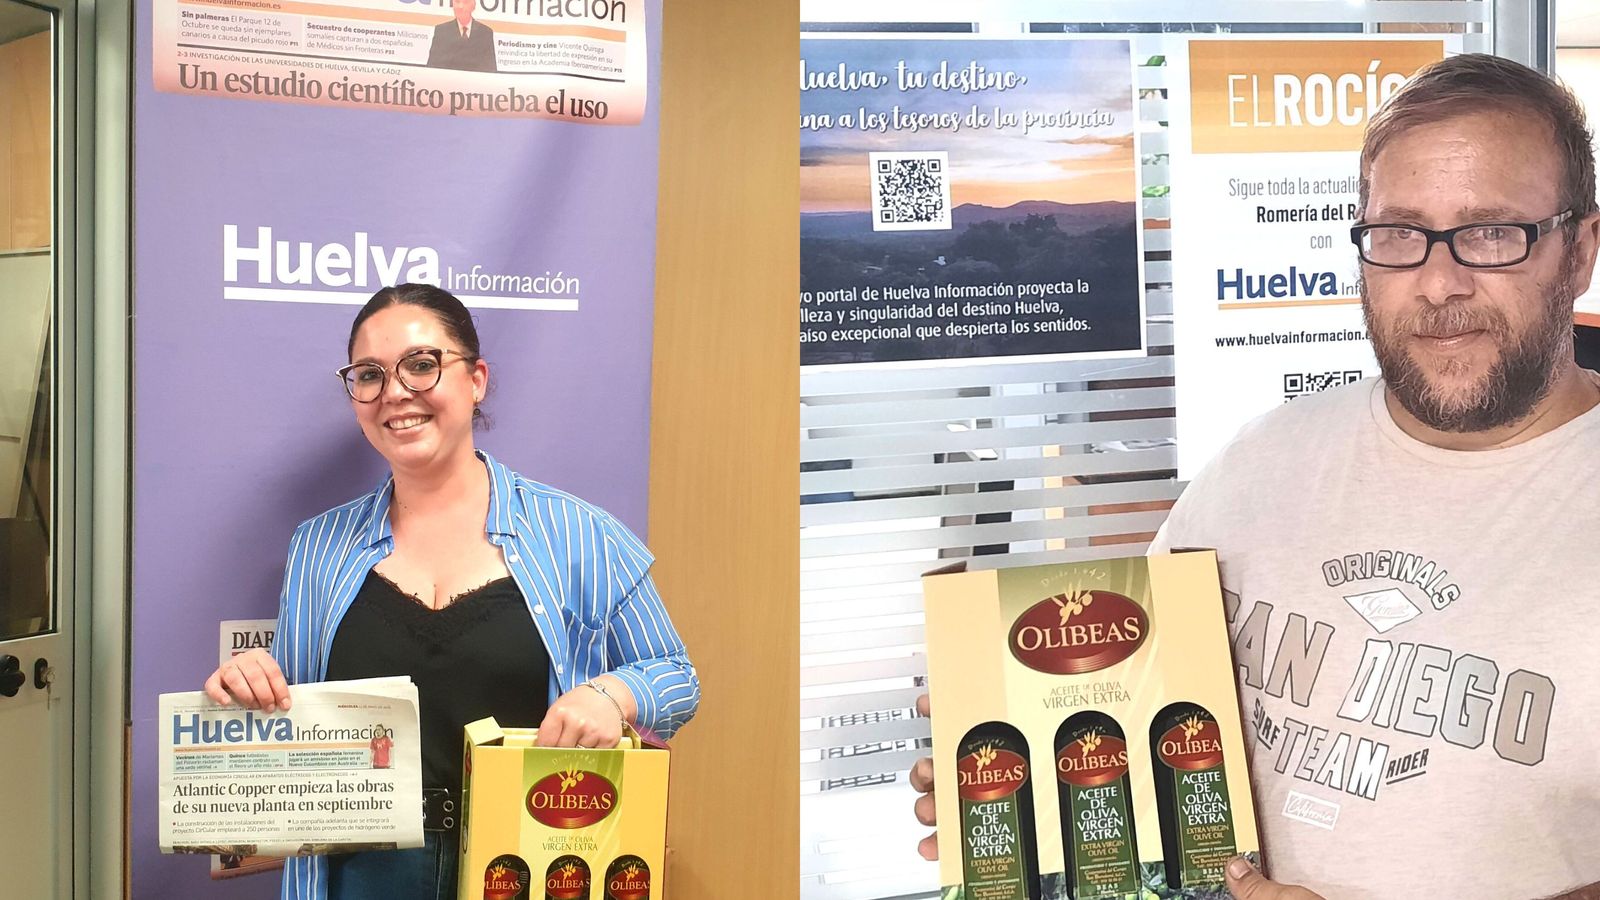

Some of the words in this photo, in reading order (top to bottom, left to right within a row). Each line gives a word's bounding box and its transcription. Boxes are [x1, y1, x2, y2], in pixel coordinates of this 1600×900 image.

[195, 13, 229, 22] palmeras
[238, 16, 262, 26] Parque
[182, 21, 210, 30] Octubre
[220, 24, 242, 34] queda
[254, 27, 292, 38] ejemplares
[307, 22, 342, 32] Secuestro
[354, 27, 396, 37] cooperantes
[182, 30, 210, 39] canarios
[251, 35, 274, 45] picudo
[276, 38, 288, 46] rojo
[336, 35, 364, 44] capturan
[498, 40, 536, 49] Periodismo
[316, 42, 343, 50] Médicos
[355, 46, 384, 54] Fronteras
[189, 51, 240, 62] INVESTIGACIÓN
[264, 58, 314, 68] UNIVERSIDADES
[382, 67, 401, 76] CÁDIZ
[894, 60, 927, 91] tu
[932, 60, 1027, 94] destino,
[178, 63, 218, 90] Un
[224, 71, 322, 99] estudio
[328, 76, 444, 108] científico
[449, 87, 540, 115] prueba
[546, 89, 565, 115] el
[570, 98, 608, 119] uso
[839, 114, 855, 128] a
[858, 107, 890, 132] los
[891, 106, 962, 132] tesoros
[965, 105, 991, 129] de
[994, 107, 1018, 129] la
[1022, 108, 1114, 135] provincia
[1229, 178, 1264, 200] Sigue
[1268, 179, 1295, 196] toda
[1298, 177, 1310, 194] la
[1257, 205, 1316, 223] Romería
[1322, 203, 1344, 221] del
[1310, 235, 1332, 249] con
[224, 224, 442, 289] Huelva
[447, 265, 580, 294] Información
[1217, 266, 1338, 300] Huelva
[816, 287, 857, 306] portal
[861, 286, 879, 300] de
[883, 284, 930, 300] Huelva
[934, 282, 1013, 298] Información
[1018, 281, 1073, 298] proyecta
[1078, 279, 1089, 293] la
[837, 310, 845, 324] y
[850, 303, 933, 323] singularidad
[937, 302, 958, 318] del
[962, 301, 1011, 316] destino
[1015, 299, 1064, 315] Huelva,
[831, 324, 911, 343] excepcional
[916, 325, 941, 340] que
[945, 322, 1007, 339] despierta
[1011, 320, 1030, 333] los
[1034, 317, 1091, 332] sentidos.
[1322, 550, 1461, 611] ORIGINALS
[1224, 588, 1335, 708] AN
[1337, 639, 1556, 767] DIEGO
[1050, 685, 1080, 697] ACEITE
[1093, 681, 1122, 692] OLIVA
[1043, 695, 1089, 709] VIRGEN
[1094, 690, 1131, 704] EXTRA
[174, 712, 294, 744] Huelva
[1274, 718, 1389, 802] TEAM
[1386, 749, 1429, 780] RIDER
[1182, 771, 1221, 784] ACEITE
[173, 783, 226, 797] Atlantic
[228, 783, 276, 798] Copper
[278, 781, 333, 796] empieza
[336, 780, 354, 793] las
[357, 779, 394, 793] obras
[1078, 786, 1117, 800] ACEITE
[1194, 783, 1210, 793] DE
[173, 800, 189, 814] de
[192, 803, 207, 813] su
[210, 802, 250, 812] nueva
[253, 798, 295, 814] planta
[298, 800, 314, 811] en
[317, 796, 393, 813] septiembre
[1090, 798, 1107, 809] DE
[1185, 792, 1222, 804] OLIVA
[970, 802, 1010, 816] ACEITE
[1081, 807, 1118, 820] OLIVA
[1182, 802, 1228, 815] VIRGEN
[982, 814, 999, 825] DE
[1077, 817, 1123, 831] VIRGEN
[1188, 812, 1225, 825] EXTRA
[972, 823, 1010, 836] OLIVA
[1083, 828, 1121, 841] EXTRA
[1193, 832, 1212, 840] OLIVE
[542, 843, 572, 851] VIRGEN
[575, 843, 598, 851] EXTRA
[968, 833, 1015, 847] VIRGEN
[973, 845, 1012, 858] EXTRA
